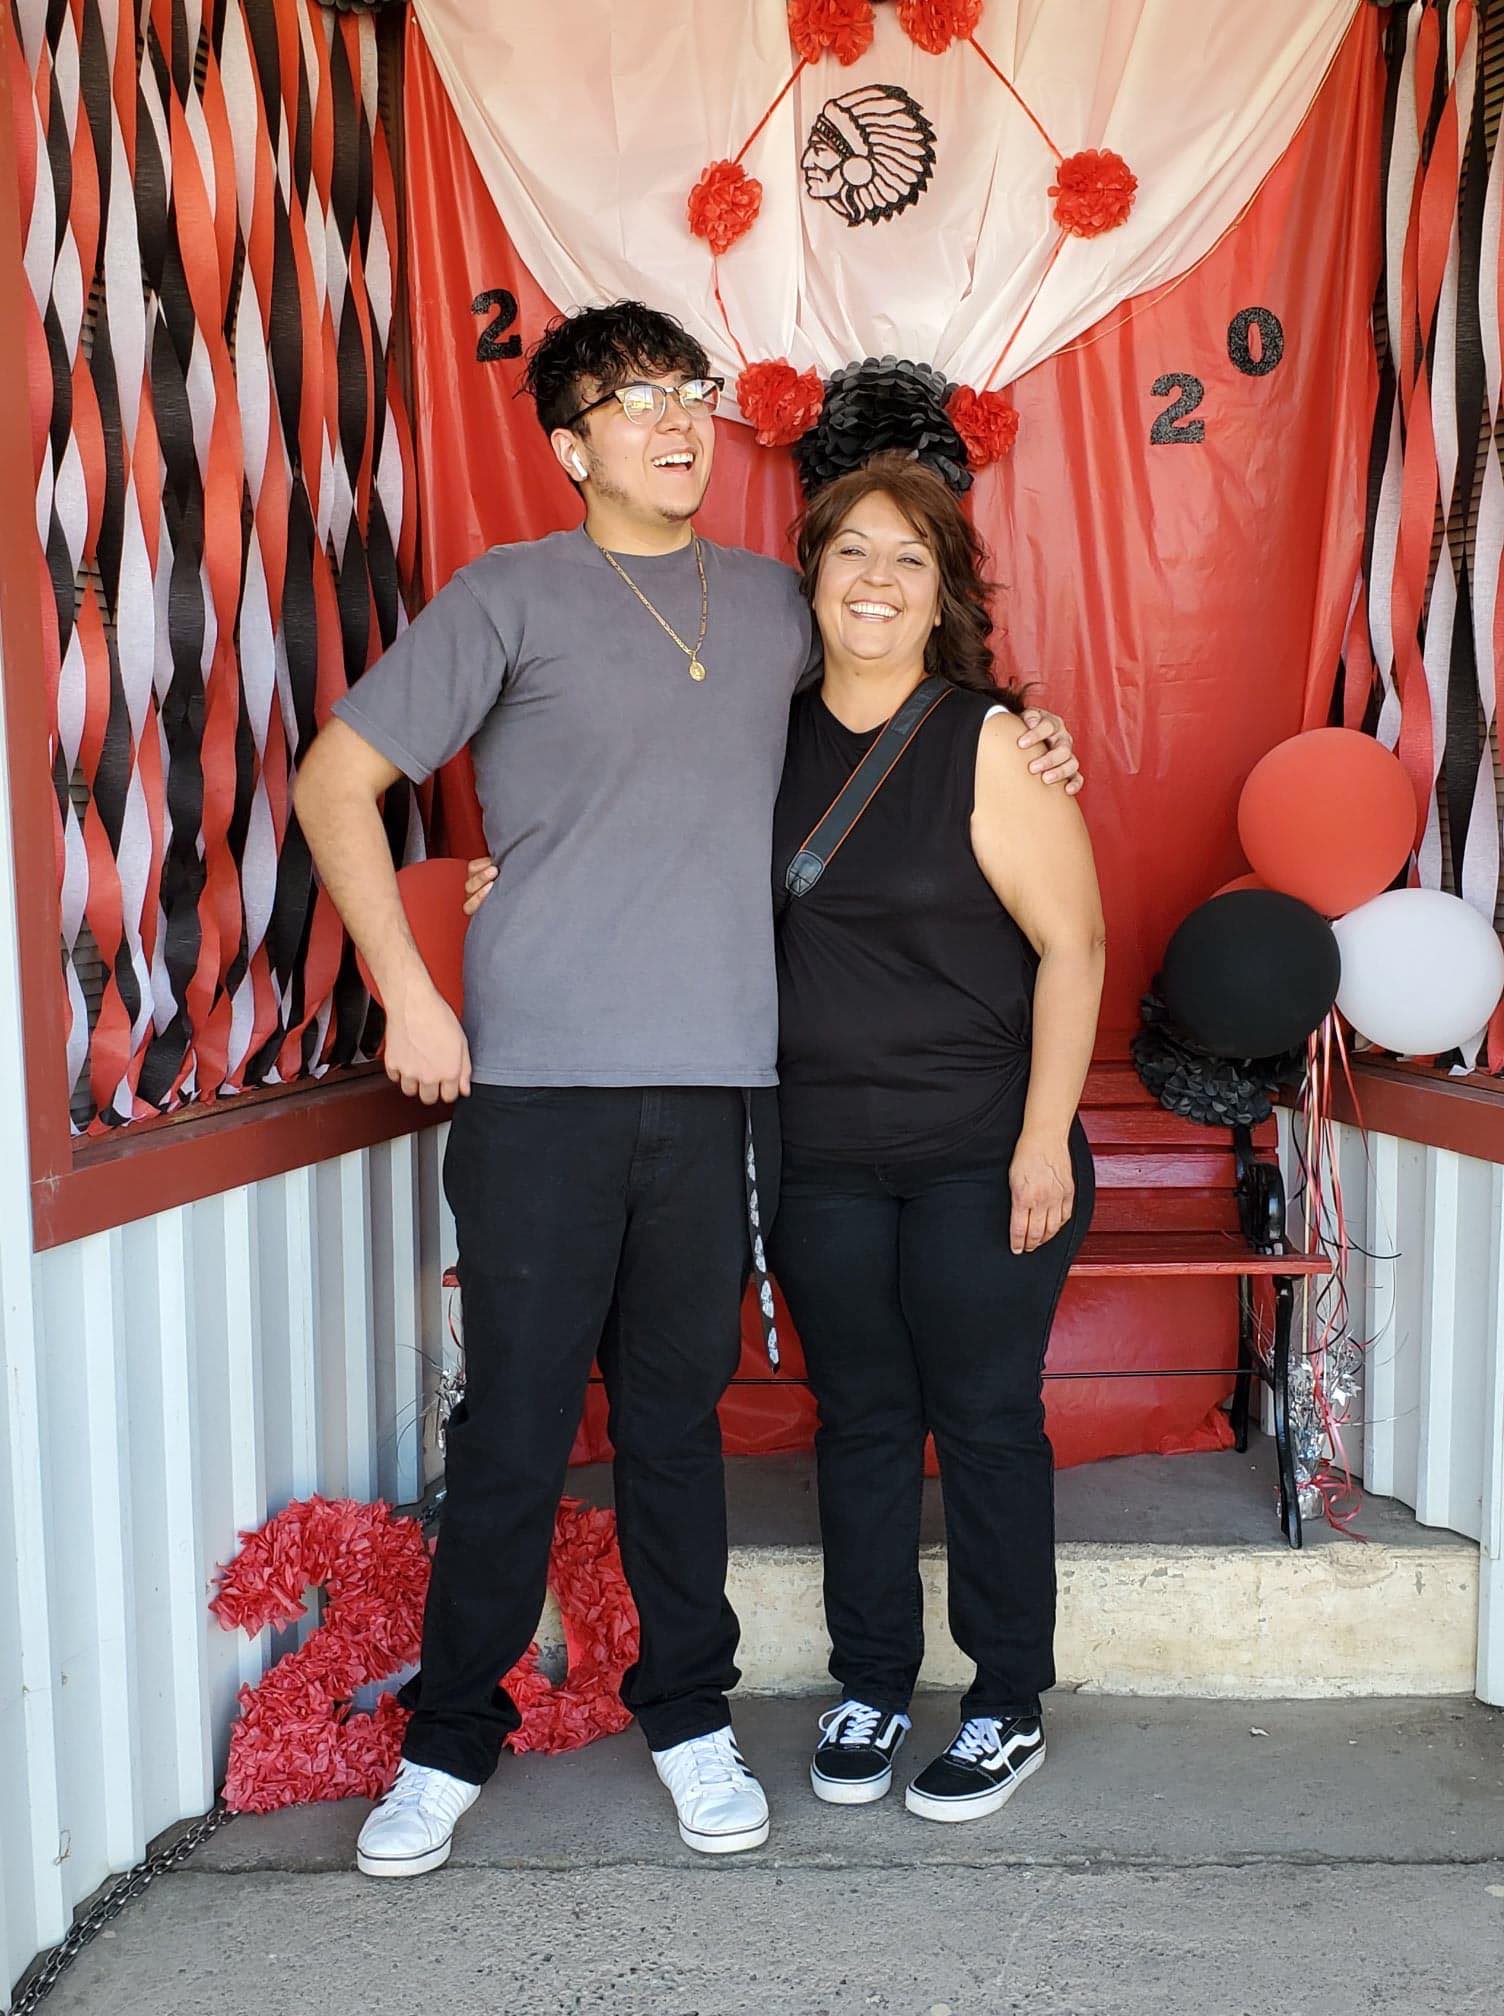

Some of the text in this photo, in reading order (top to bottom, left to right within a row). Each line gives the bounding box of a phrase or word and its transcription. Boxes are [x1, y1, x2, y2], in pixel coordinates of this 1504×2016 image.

[471, 288, 522, 362] 2
[1151, 307, 1284, 445] 2 0
[209, 1494, 432, 1815] 2
